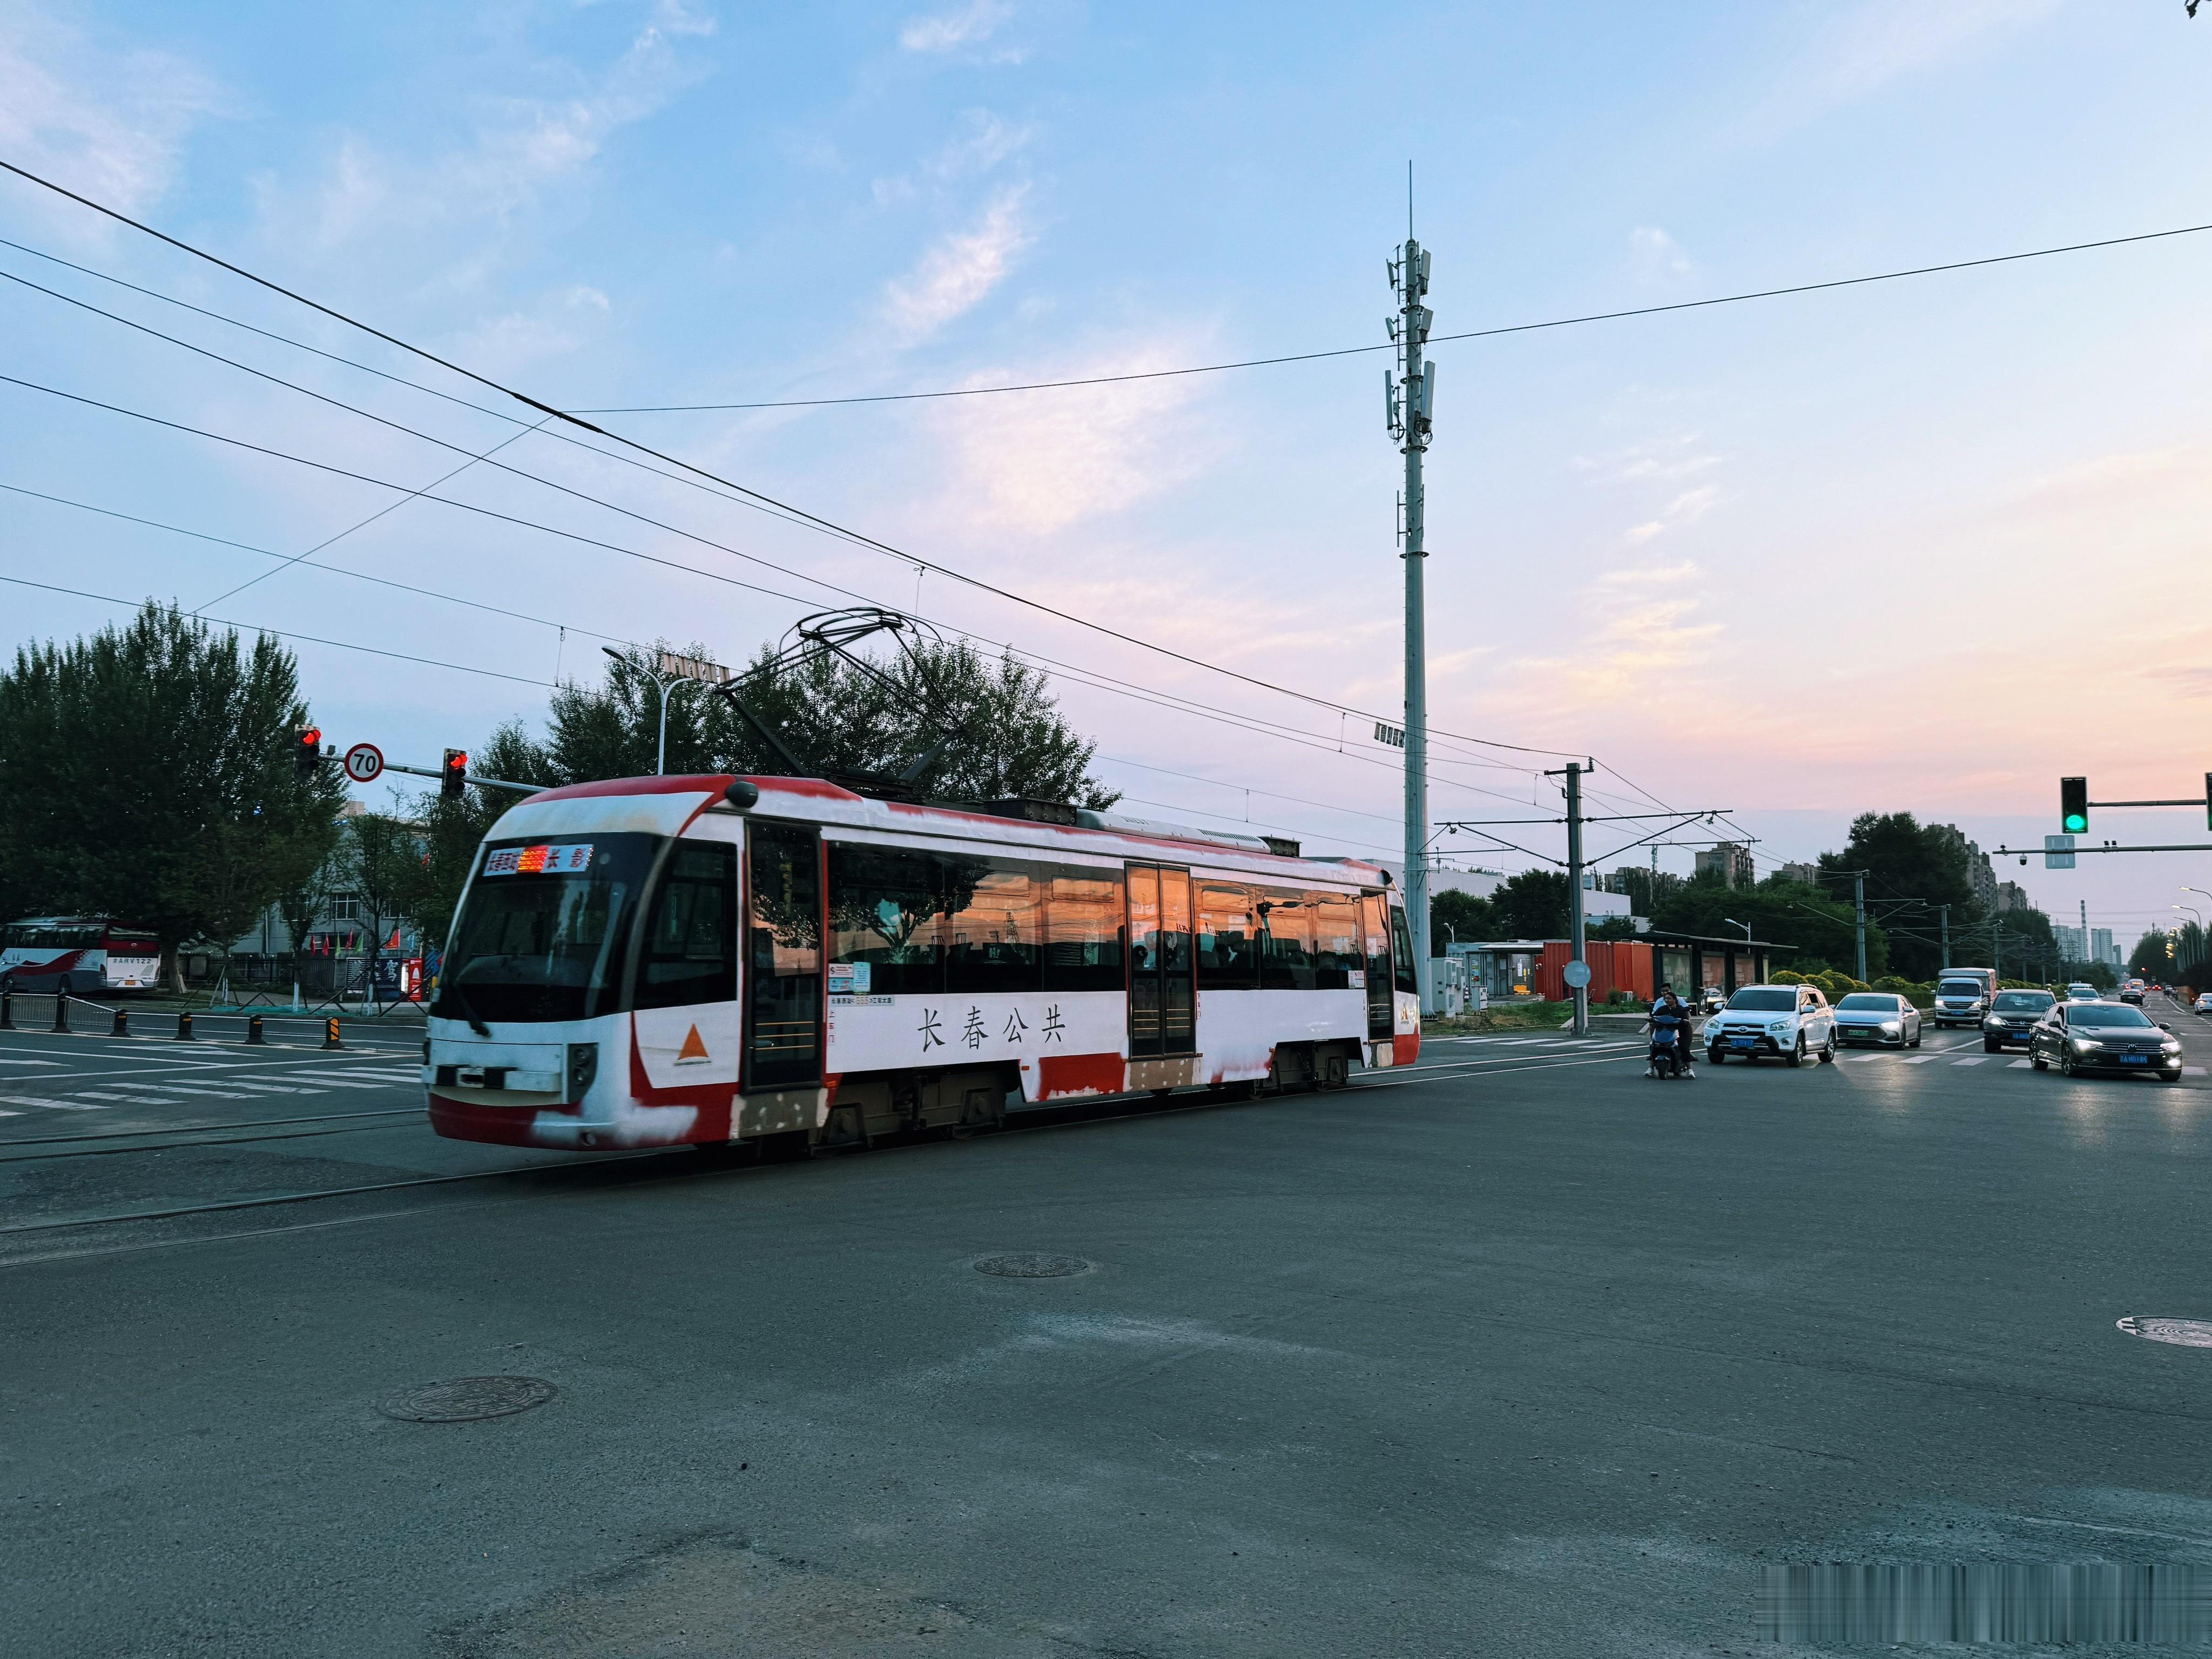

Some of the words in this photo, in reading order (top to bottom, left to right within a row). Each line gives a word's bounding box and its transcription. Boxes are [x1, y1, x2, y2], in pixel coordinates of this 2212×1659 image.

[354, 753, 376, 772] 70
[918, 1004, 1065, 1053] 长春公共
